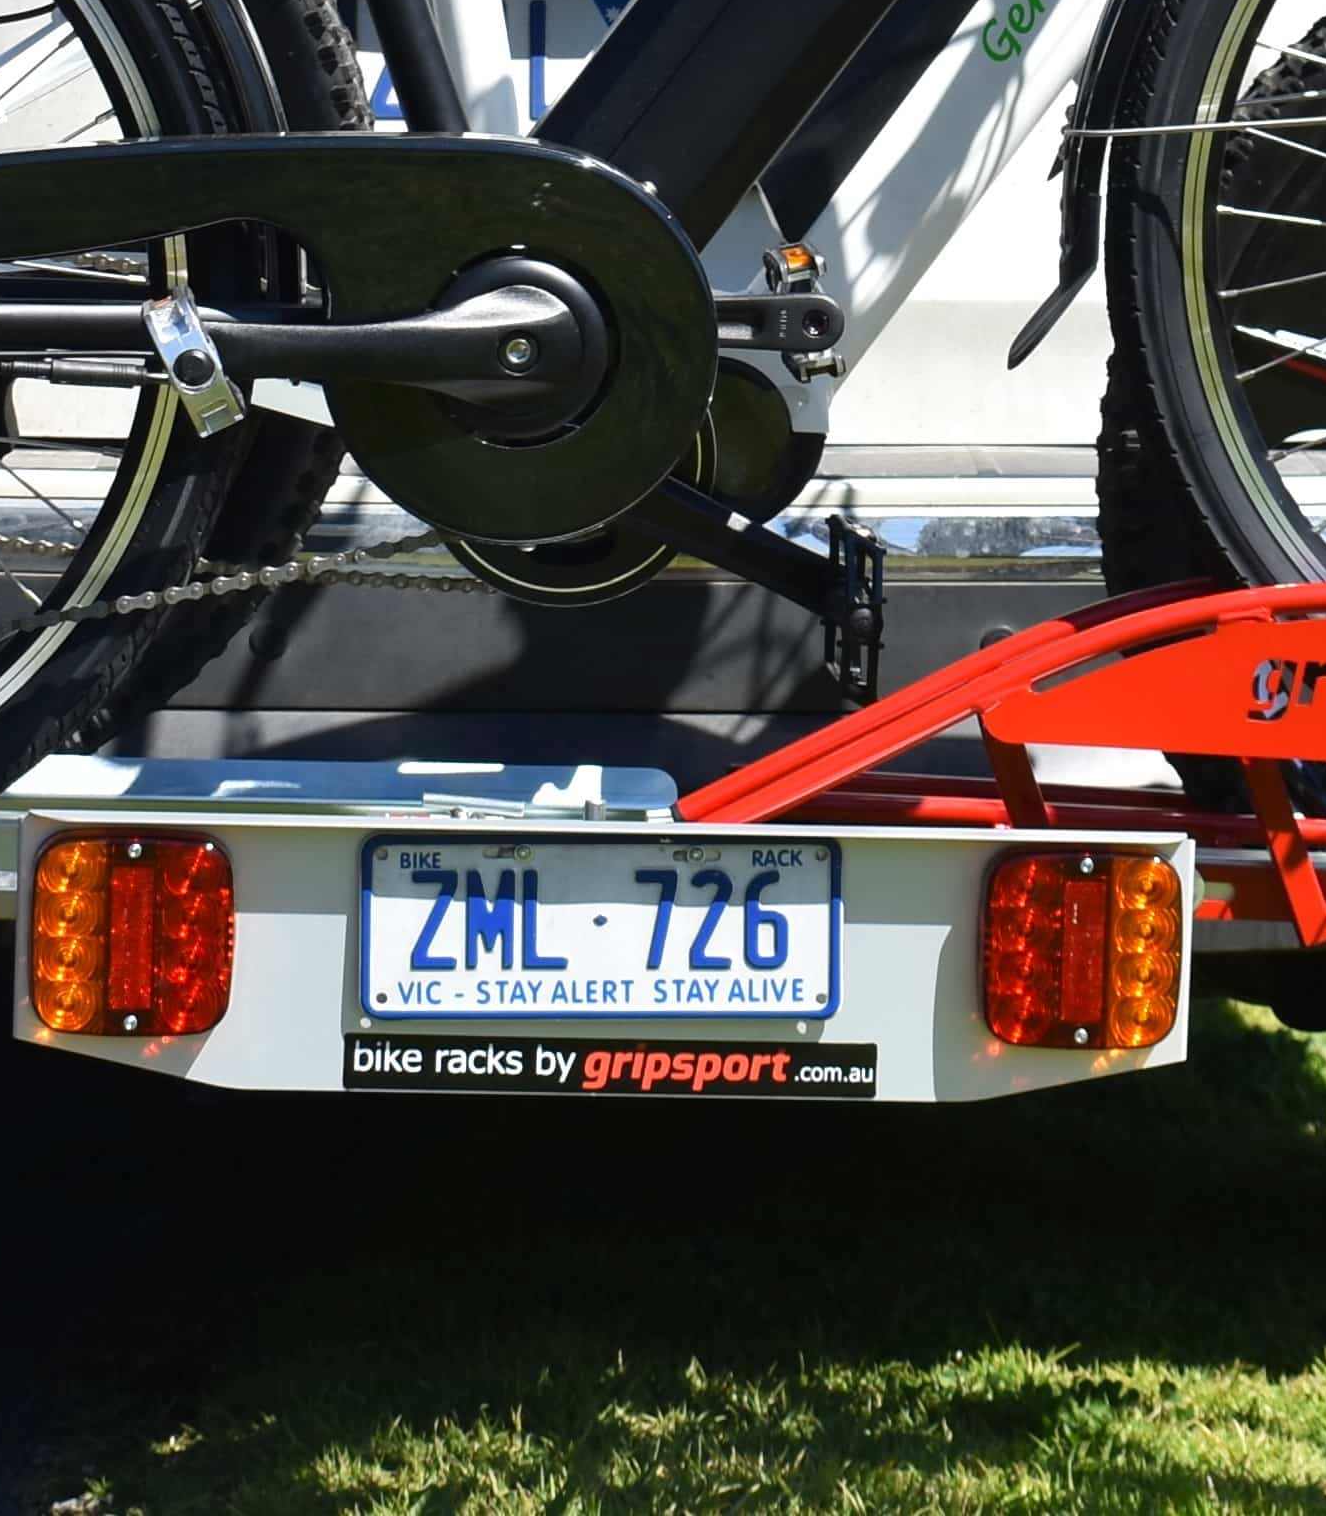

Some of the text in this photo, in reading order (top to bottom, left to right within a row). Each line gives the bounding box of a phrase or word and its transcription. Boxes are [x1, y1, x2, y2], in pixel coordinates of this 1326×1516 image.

[399, 848, 804, 871] BIKE RACK
[409, 869, 790, 972] ZML 726
[398, 980, 443, 1005] VIC
[476, 979, 543, 1005] STAY
[550, 979, 634, 1005] ALERT
[653, 979, 723, 1004] STAY
[727, 978, 805, 1003] ALIVE
[353, 1041, 874, 1091] bike racks by gripsport .com.au
